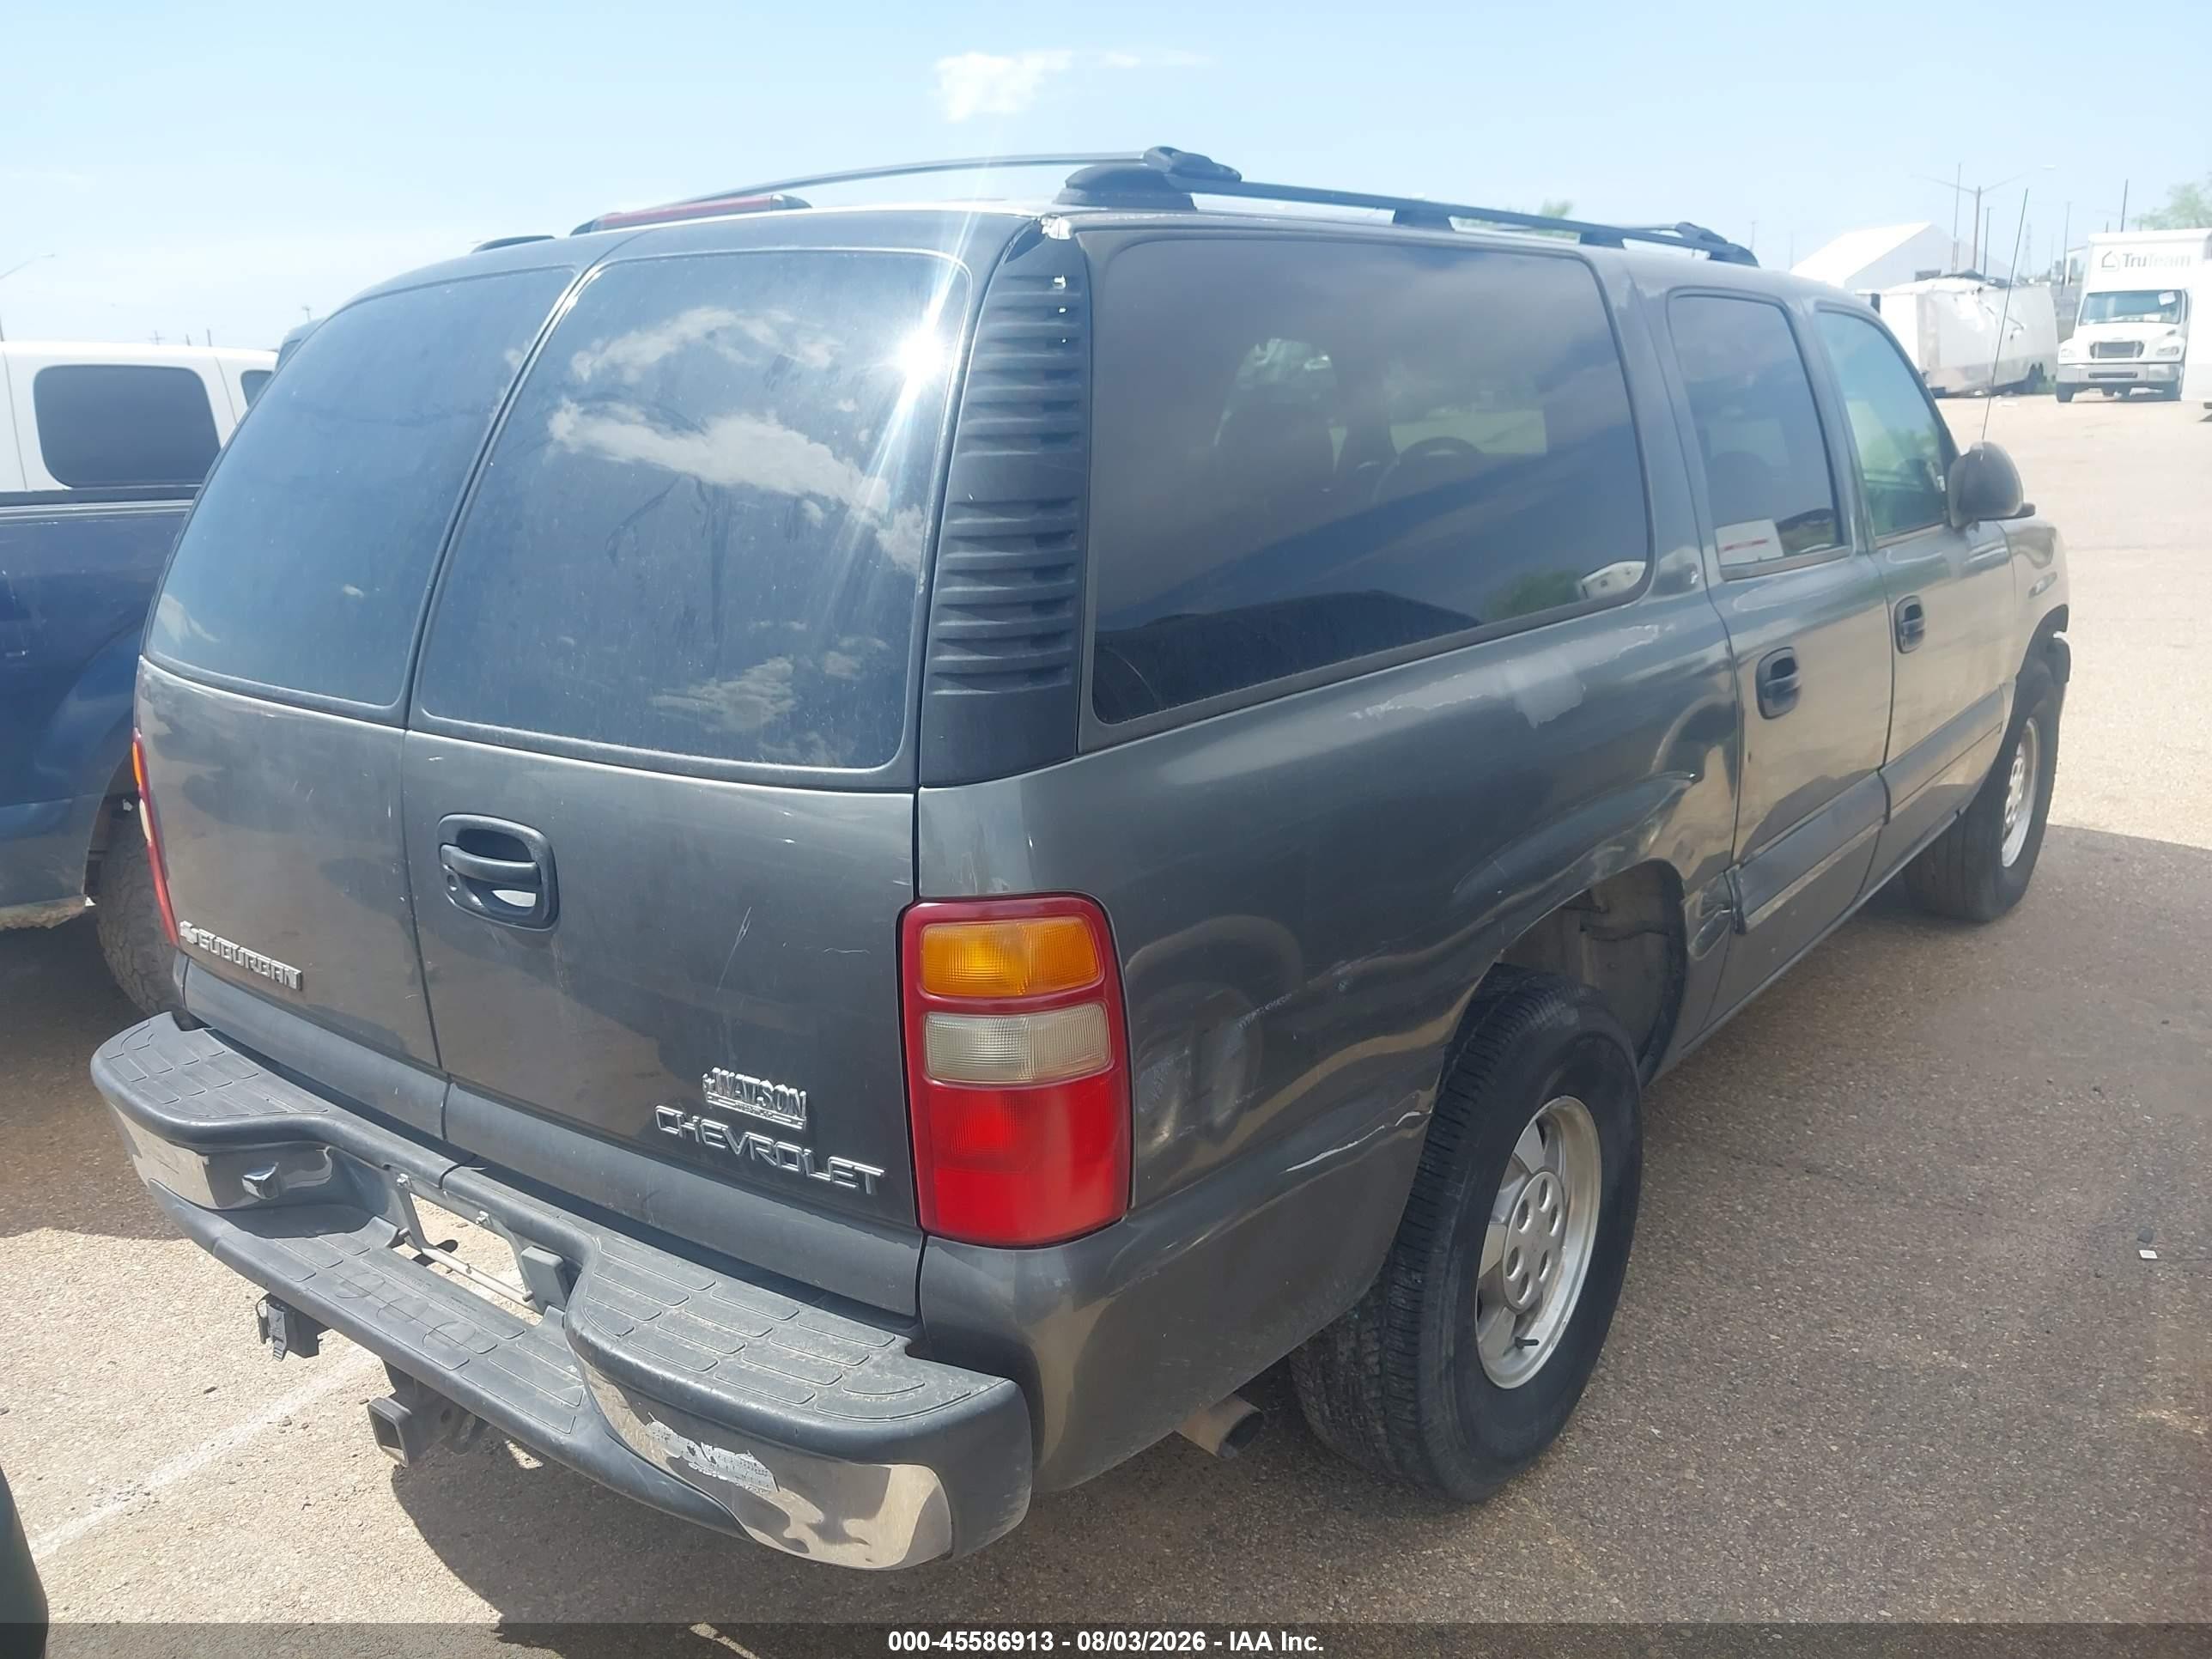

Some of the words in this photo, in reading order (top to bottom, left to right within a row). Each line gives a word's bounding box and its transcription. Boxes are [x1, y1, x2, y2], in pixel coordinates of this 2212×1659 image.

[2122, 252, 2191, 268] TruTeam
[198, 928, 303, 990] SUBURBAN
[711, 1066, 807, 1119] WATSON
[654, 1104, 885, 1194] CHEVROLET
